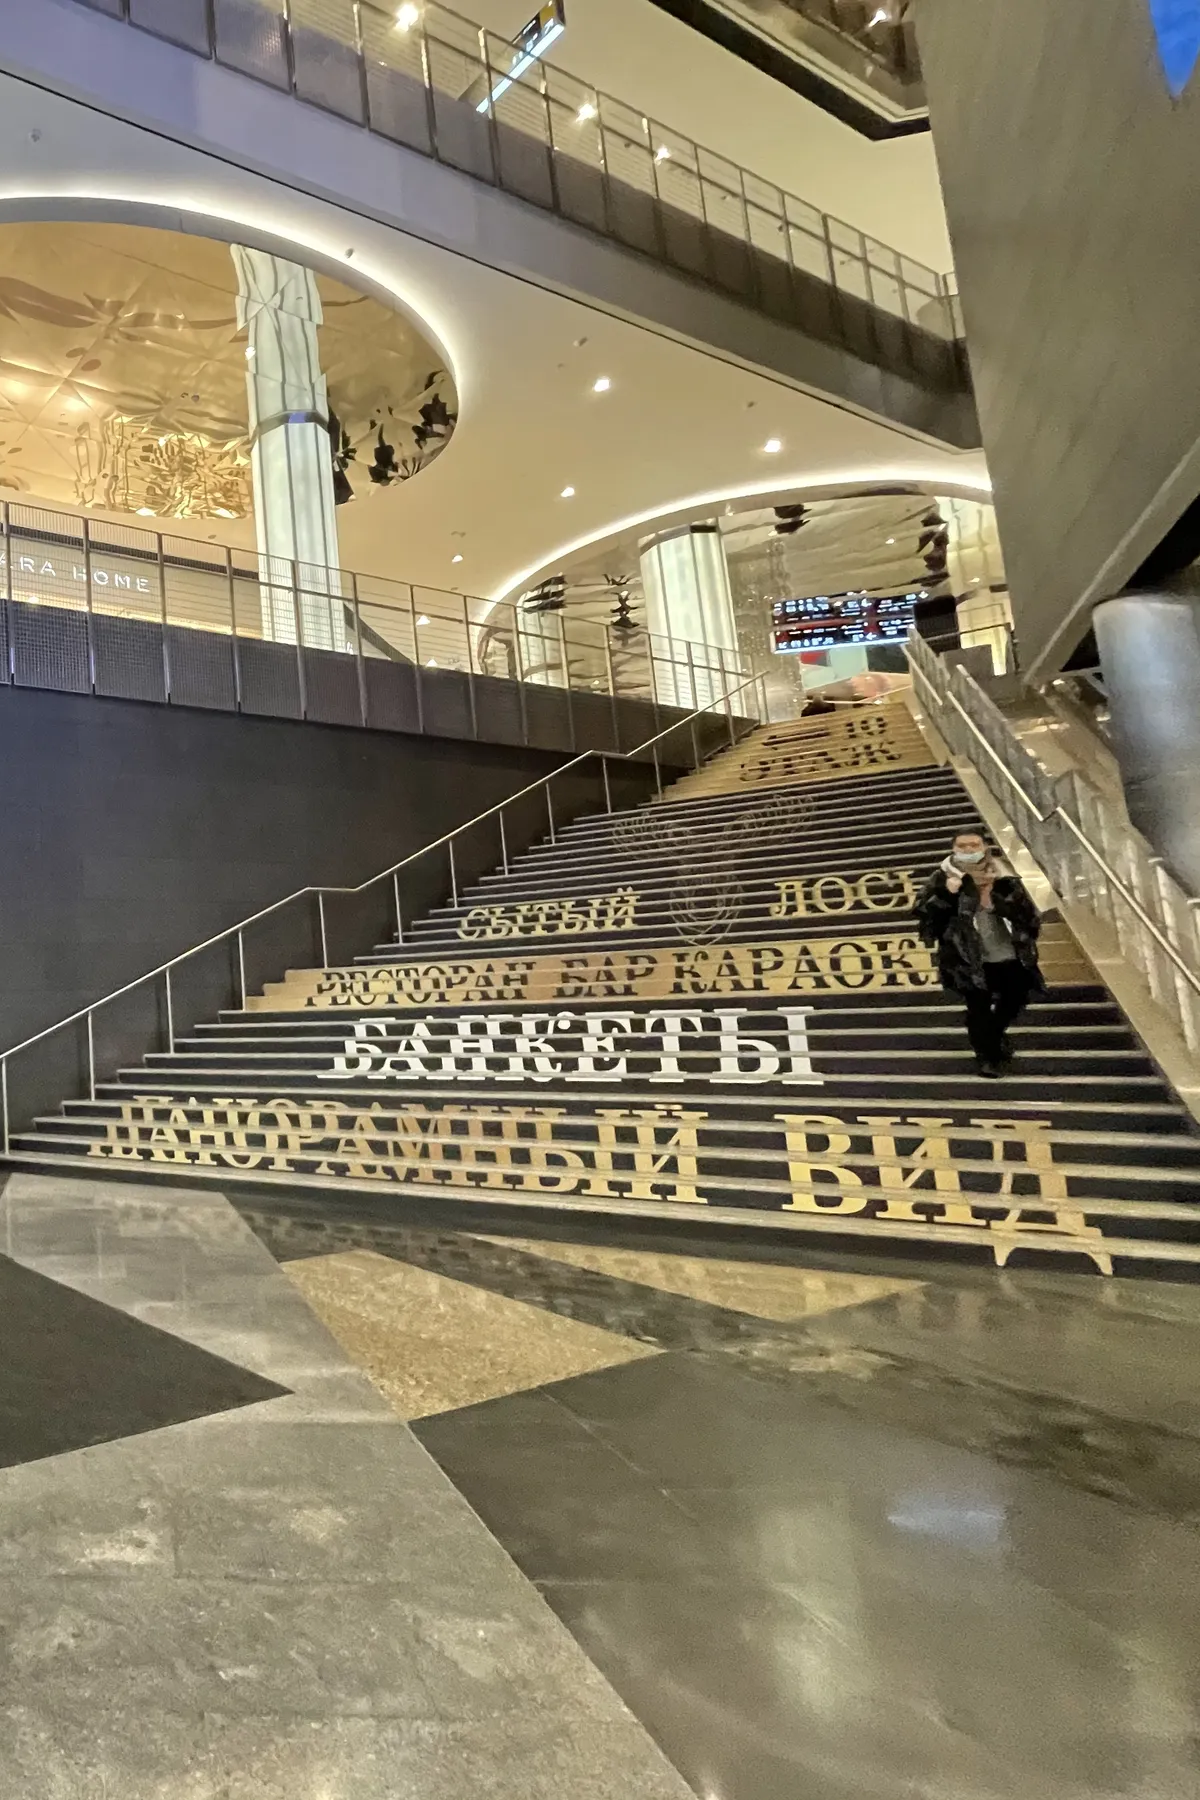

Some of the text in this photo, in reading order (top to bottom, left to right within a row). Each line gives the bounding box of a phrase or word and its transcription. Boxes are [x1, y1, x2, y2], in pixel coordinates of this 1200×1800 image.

[73, 566, 150, 593] HOME
[457, 887, 640, 940] СЫТЫЙ
[304, 938, 941, 1007] РЕСТОРАН БАР КАРАОК
[316, 1007, 824, 1085] БАНКЕТЫ
[86, 1095, 1113, 1276] ПАНОРАМНЫЙ ВИД
